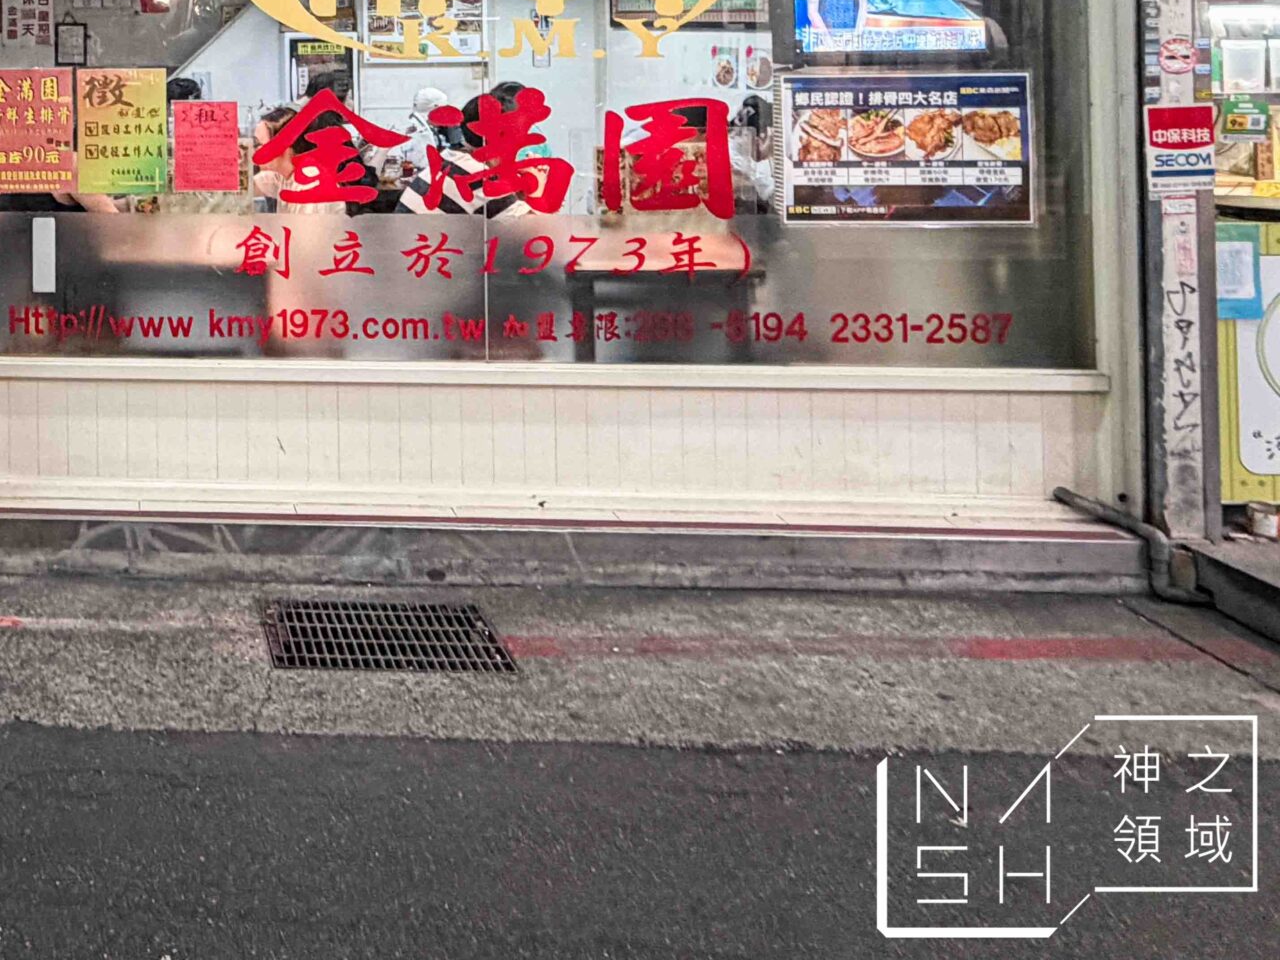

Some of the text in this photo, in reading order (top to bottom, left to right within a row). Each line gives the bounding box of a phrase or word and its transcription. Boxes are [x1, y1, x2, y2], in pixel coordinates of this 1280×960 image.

[1152, 128, 1211, 145] 中保科技
[251, 86, 735, 220] 金滿園
[1154, 152, 1212, 168] SECOM
[830, 312, 1013, 344] 2331-2587
